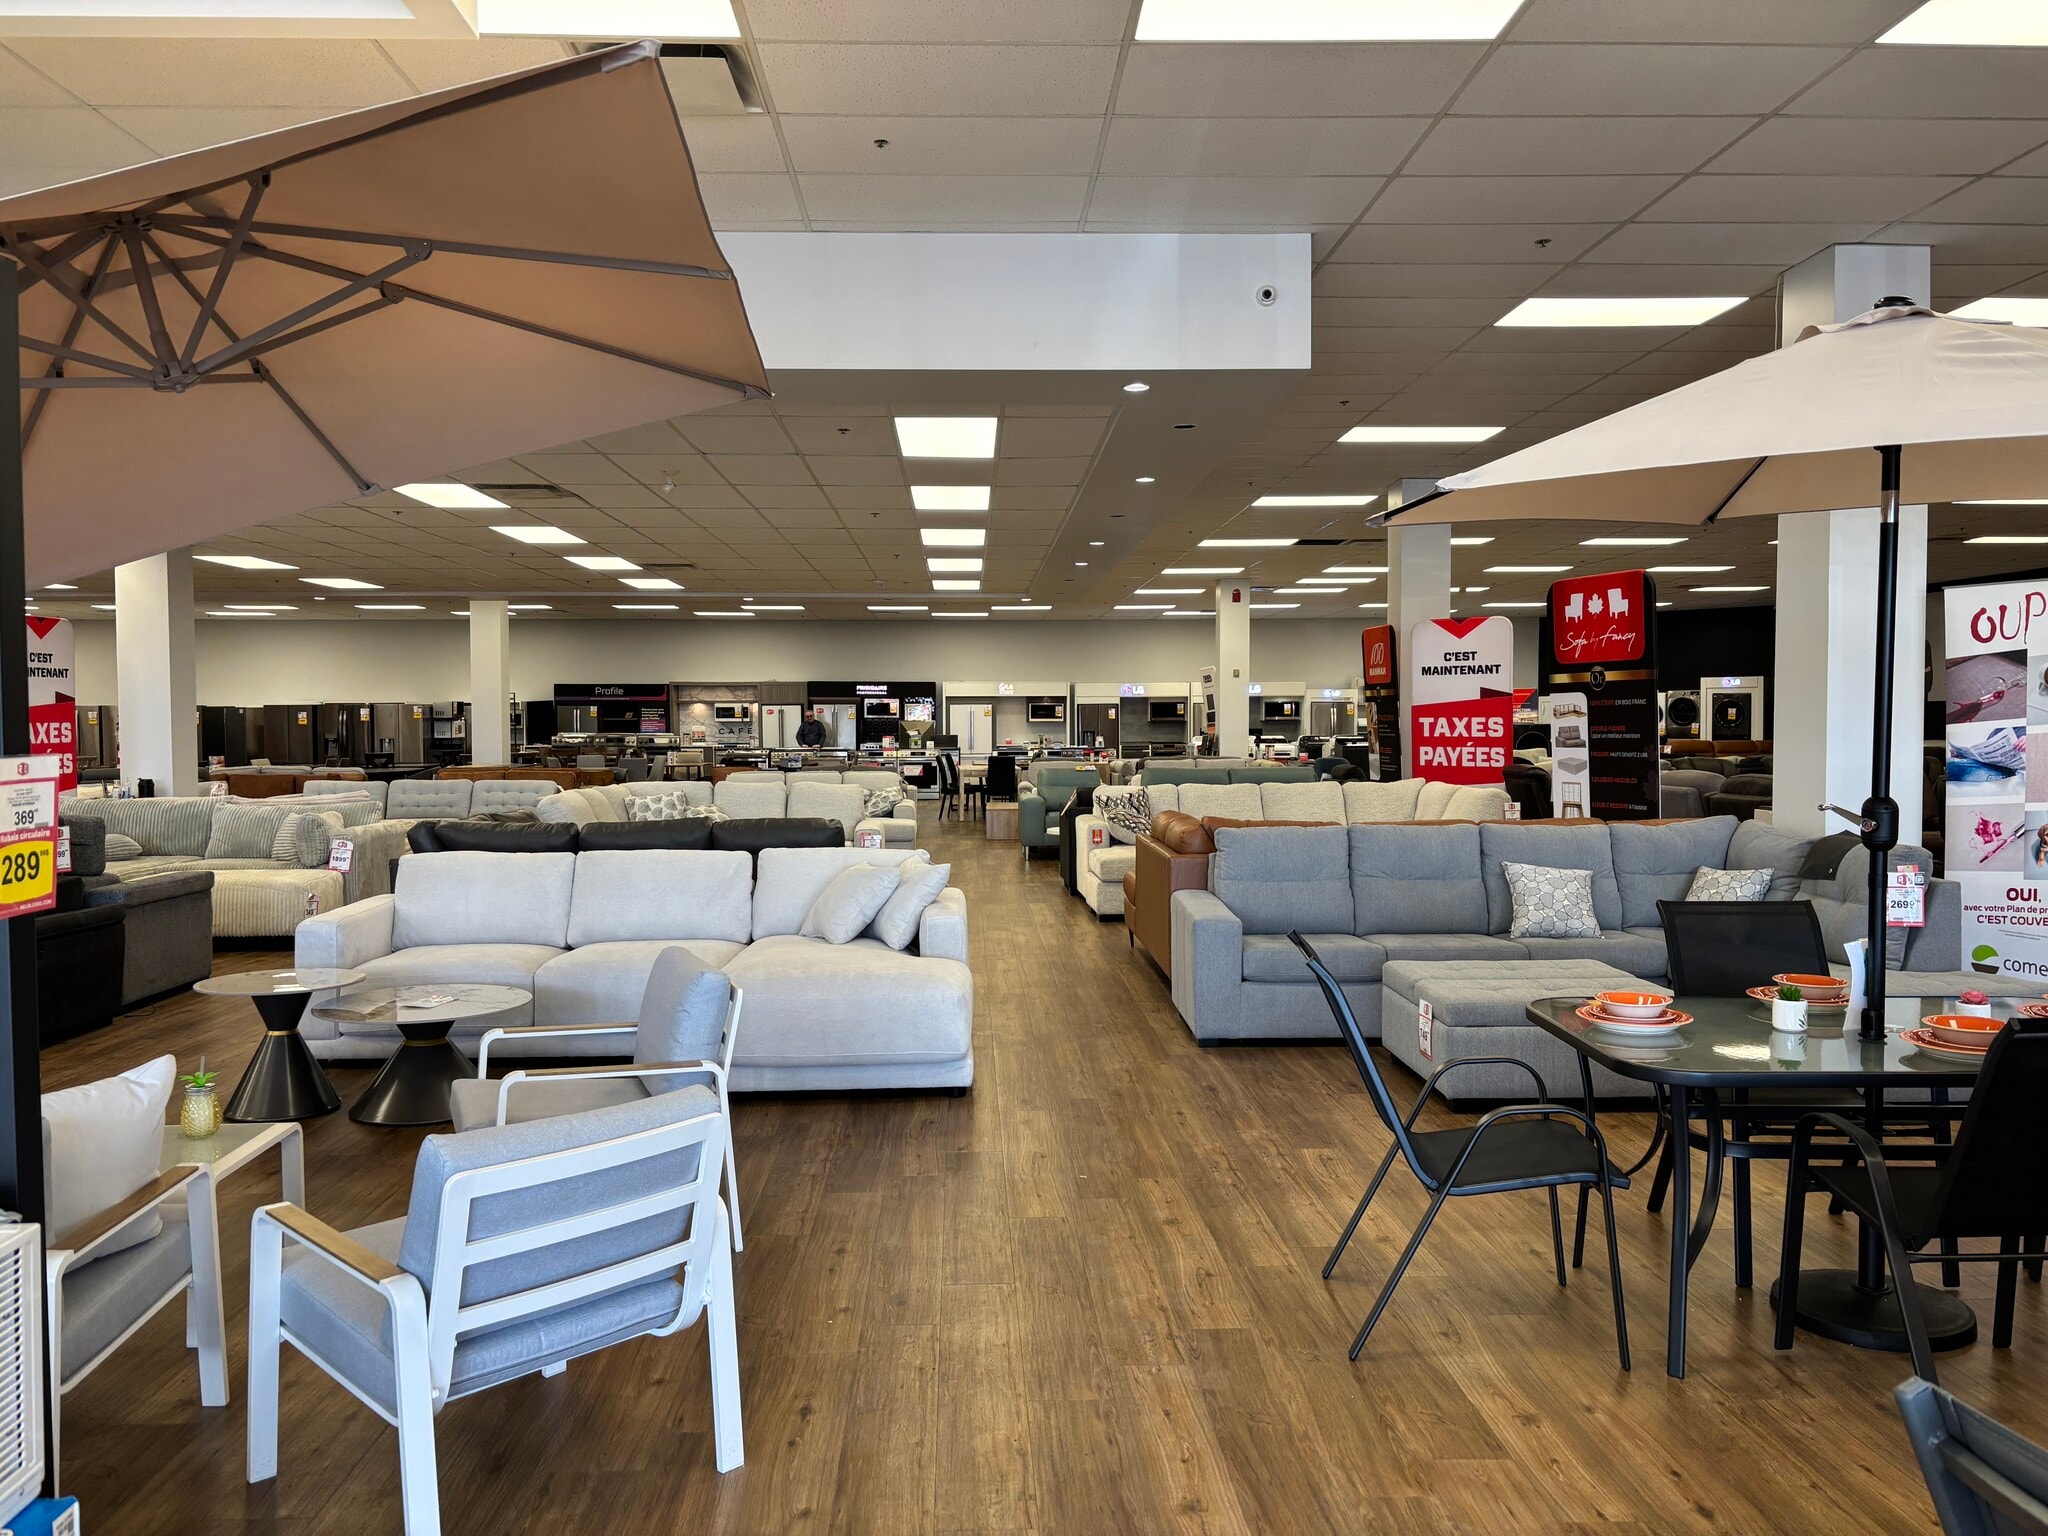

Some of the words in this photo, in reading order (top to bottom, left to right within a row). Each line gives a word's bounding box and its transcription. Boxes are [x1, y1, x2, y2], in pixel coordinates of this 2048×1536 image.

[29, 652, 53, 664] C'EST
[1443, 651, 1478, 662] C'EST
[1421, 664, 1502, 676] MAINTENANT
[595, 686, 624, 695] Profile
[1132, 685, 1145, 695] LG
[1418, 716, 1504, 738] TAXES
[1419, 741, 1505, 768] PAYÉES
[14, 810, 34, 826] 369
[20, 828, 51, 840] circulaire
[2, 850, 40, 886] 289
[2006, 887, 2042, 903] OUI,
[2006, 904, 2026, 914] Plan
[2027, 906, 2038, 914] de
[1976, 914, 2008, 925] C'EST
